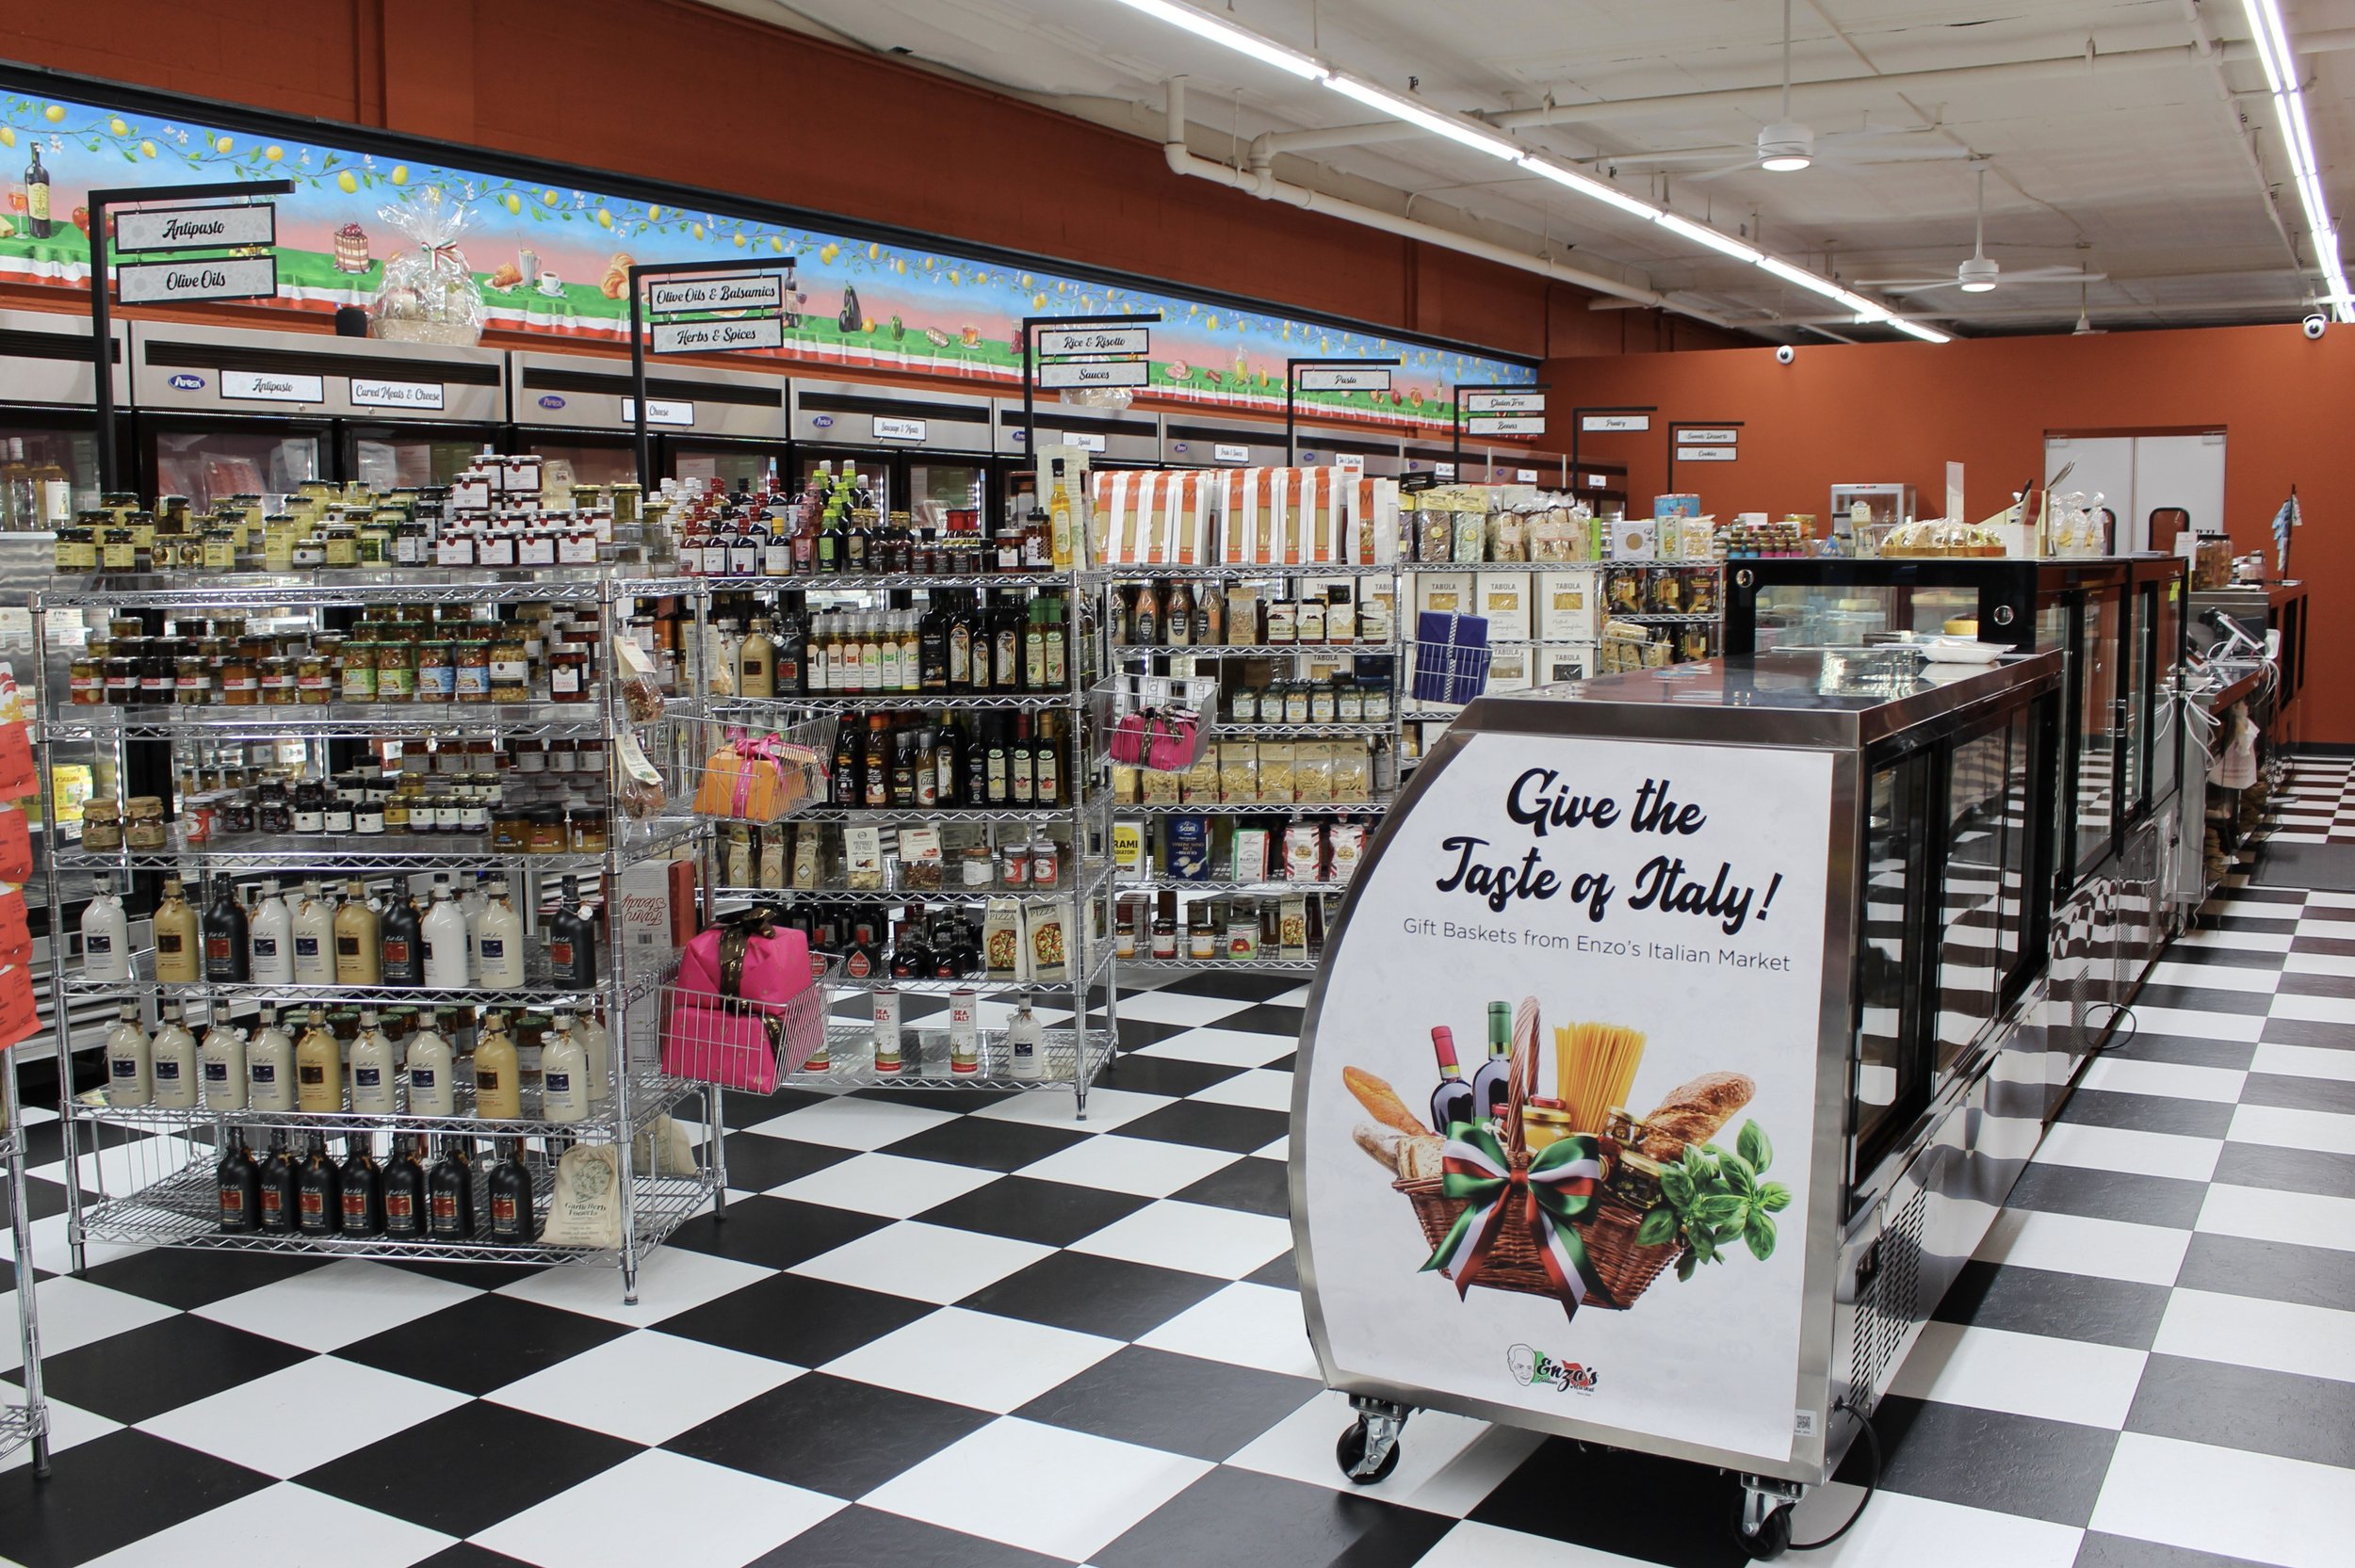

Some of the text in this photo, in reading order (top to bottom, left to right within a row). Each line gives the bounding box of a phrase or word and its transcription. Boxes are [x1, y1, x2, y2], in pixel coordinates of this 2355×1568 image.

[162, 218, 225, 240] Antipasto
[167, 269, 226, 290] Olive Oils
[657, 285, 775, 305] Olive Oils & Balsamics
[677, 327, 756, 345] Herbs & Spices
[1064, 335, 1126, 349] Rice & Risotto
[1079, 368, 1110, 380] Sauces
[1334, 374, 1356, 384] Pasta
[252, 378, 293, 394] Antipasto
[355, 384, 440, 401] Cured Meats & Cheese
[649, 405, 669, 416] Cheese
[1491, 398, 1511, 408] Gluten
[1498, 421, 1518, 429] Beans
[1507, 768, 1707, 838] Give the
[1114, 840, 1138, 849] RAMI
[1436, 836, 1783, 936] Taste of Italy!
[622, 893, 667, 912] Steady
[624, 910, 663, 927] Farm
[1030, 907, 1055, 917] PIZZA
[1404, 917, 1791, 972] Gift Baskets from Enzo's Italian Market
[1536, 1357, 1598, 1392] Enzo's
